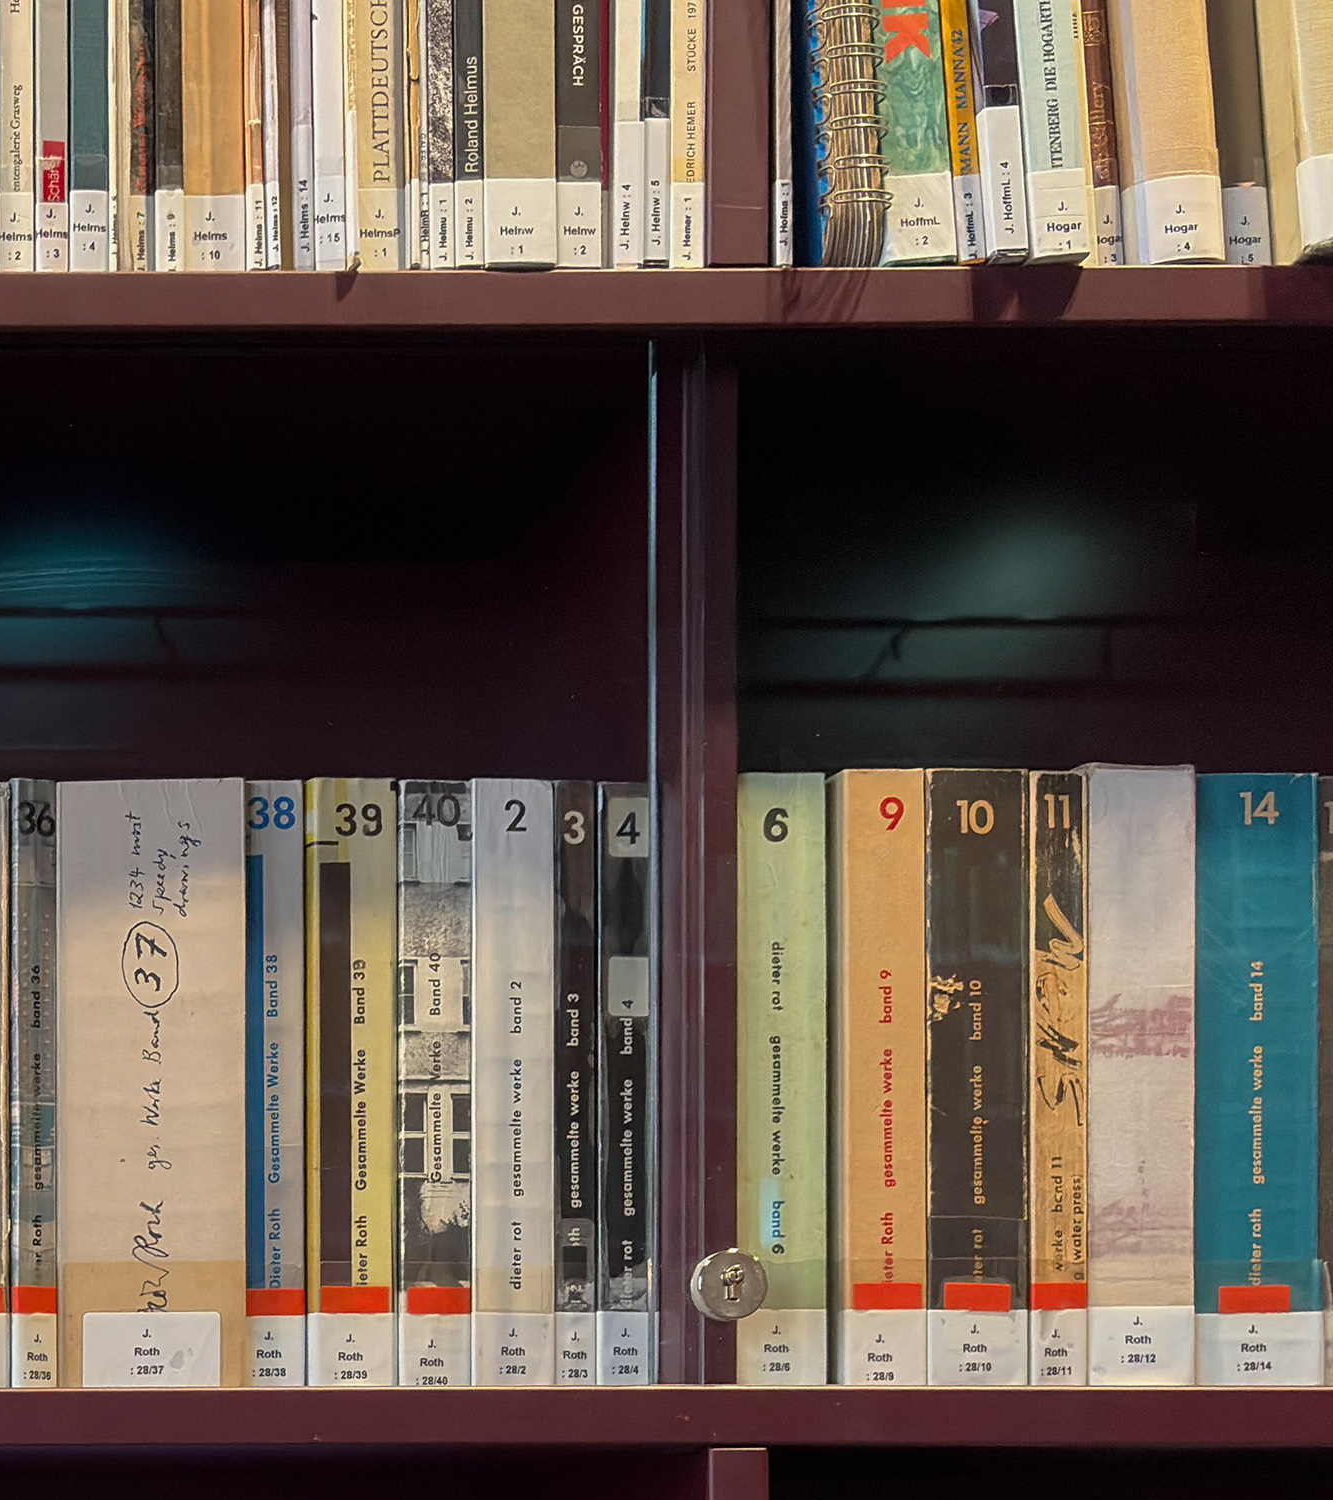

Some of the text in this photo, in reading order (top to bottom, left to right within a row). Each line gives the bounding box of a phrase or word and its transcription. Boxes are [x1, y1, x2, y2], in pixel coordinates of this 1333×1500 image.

[572, 4, 585, 87] GESPRÄCH
[466, 57, 479, 173] Roland Helmus
[194, 230, 227, 242] Helms
[900, 217, 940, 228] HoffmL
[1165, 222, 1198, 235] Hogar
[247, 796, 297, 831] 38
[762, 807, 789, 844] 6
[879, 796, 905, 832] 9
